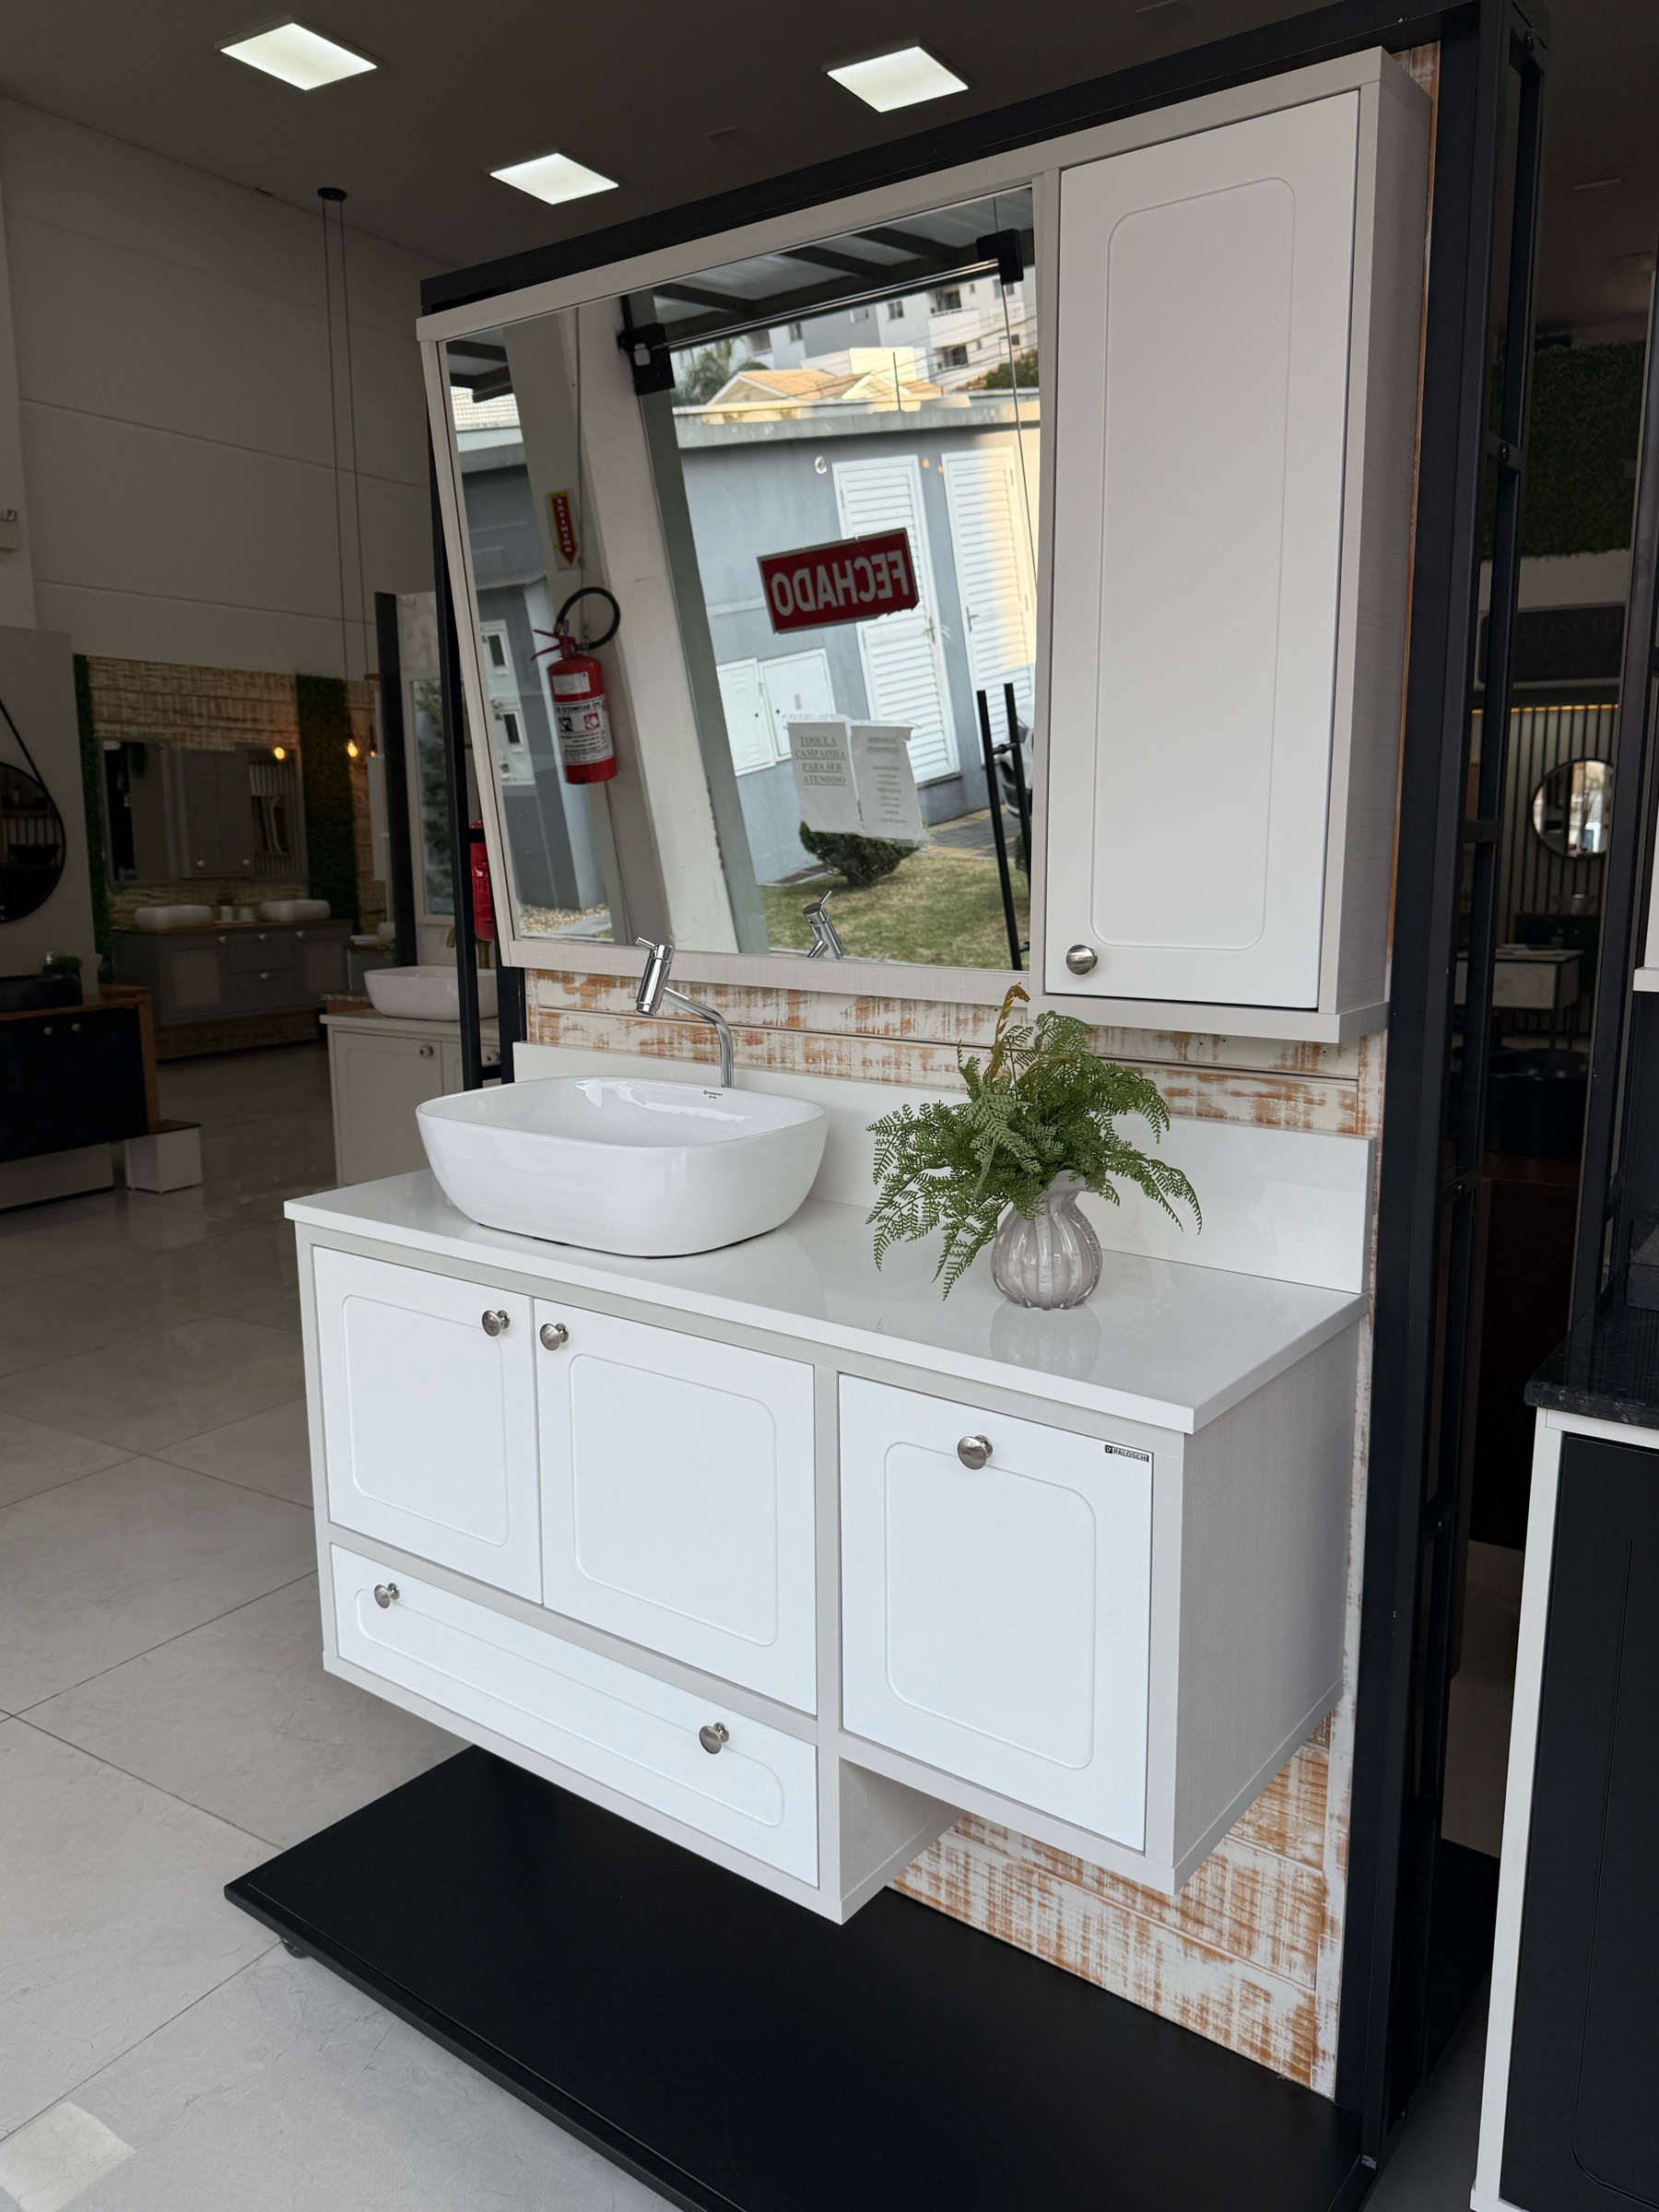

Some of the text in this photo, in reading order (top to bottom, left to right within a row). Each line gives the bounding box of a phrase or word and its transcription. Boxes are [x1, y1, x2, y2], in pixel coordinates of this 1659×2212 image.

[799, 736, 837, 747] TOQUE A
[794, 748, 845, 759] CAMPAINHA
[801, 762, 842, 773] PARA SER
[803, 775, 846, 786] ATENDIDO
